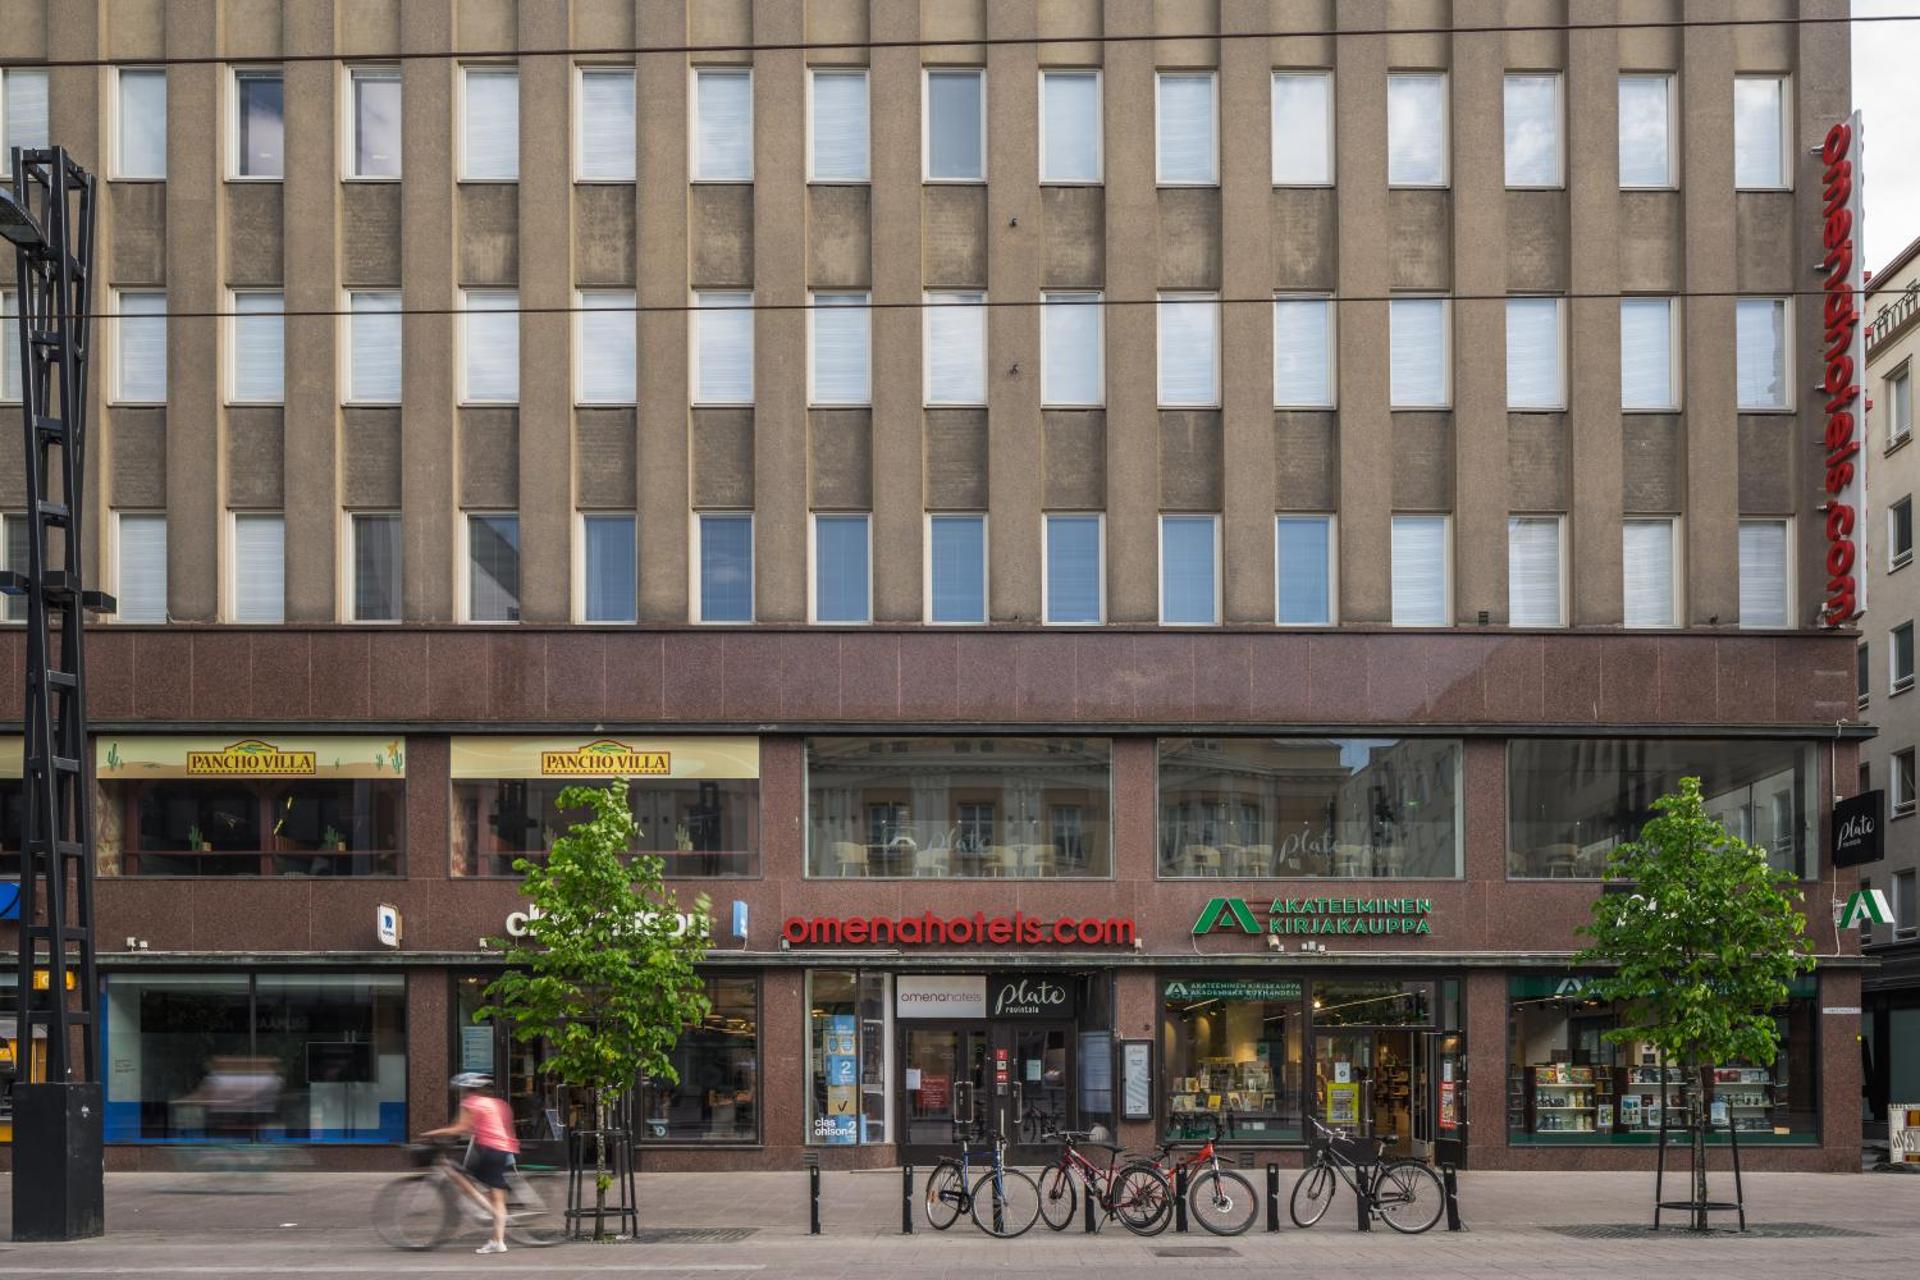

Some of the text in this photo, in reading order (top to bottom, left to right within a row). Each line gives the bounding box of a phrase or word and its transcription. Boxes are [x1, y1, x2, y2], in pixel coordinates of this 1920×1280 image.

[1823, 123, 1860, 627] omenahotels.com
[191, 755, 312, 769] PANCHO VILLA
[546, 755, 666, 769] PANCHO VILLA
[1269, 897, 1432, 914] AKATEEMINEN
[782, 911, 1136, 945] omenahotels.com
[1269, 917, 1432, 935] KIRJAKAUPPA
[901, 991, 982, 1002] omenahotels
[814, 1117, 836, 1127] clas
[814, 1127, 848, 1136] ohlson
